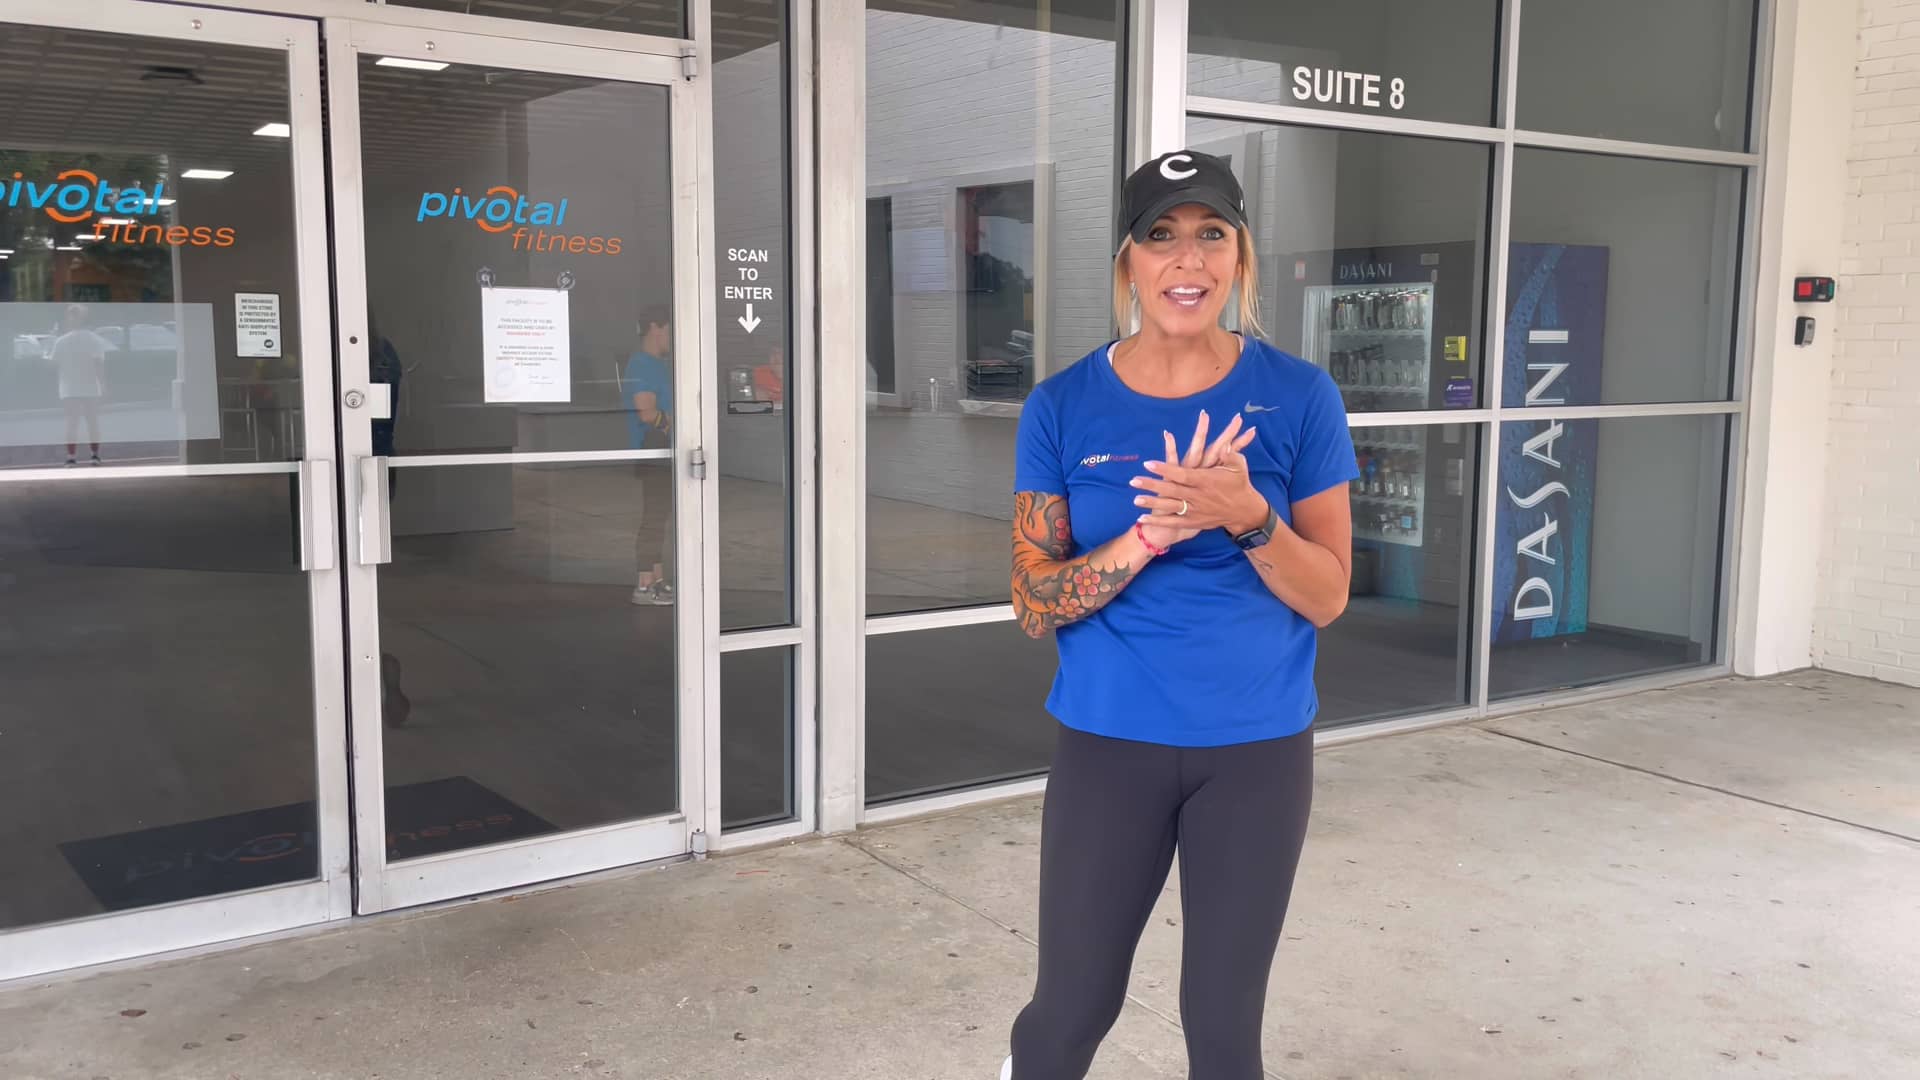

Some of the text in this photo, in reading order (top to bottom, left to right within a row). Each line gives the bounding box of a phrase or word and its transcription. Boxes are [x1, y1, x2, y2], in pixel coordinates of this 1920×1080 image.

[1292, 66, 1406, 110] SUITE 8
[1159, 153, 1199, 181] C
[0, 171, 165, 216] ivotal
[417, 187, 568, 227] pivotal
[92, 222, 236, 248] fitness
[511, 227, 623, 256] fitness
[727, 247, 769, 263] SCAN
[738, 267, 759, 282] TO
[1340, 263, 1393, 281] DASANI
[724, 286, 774, 301] ENTER
[1507, 329, 1571, 622] DASANI
